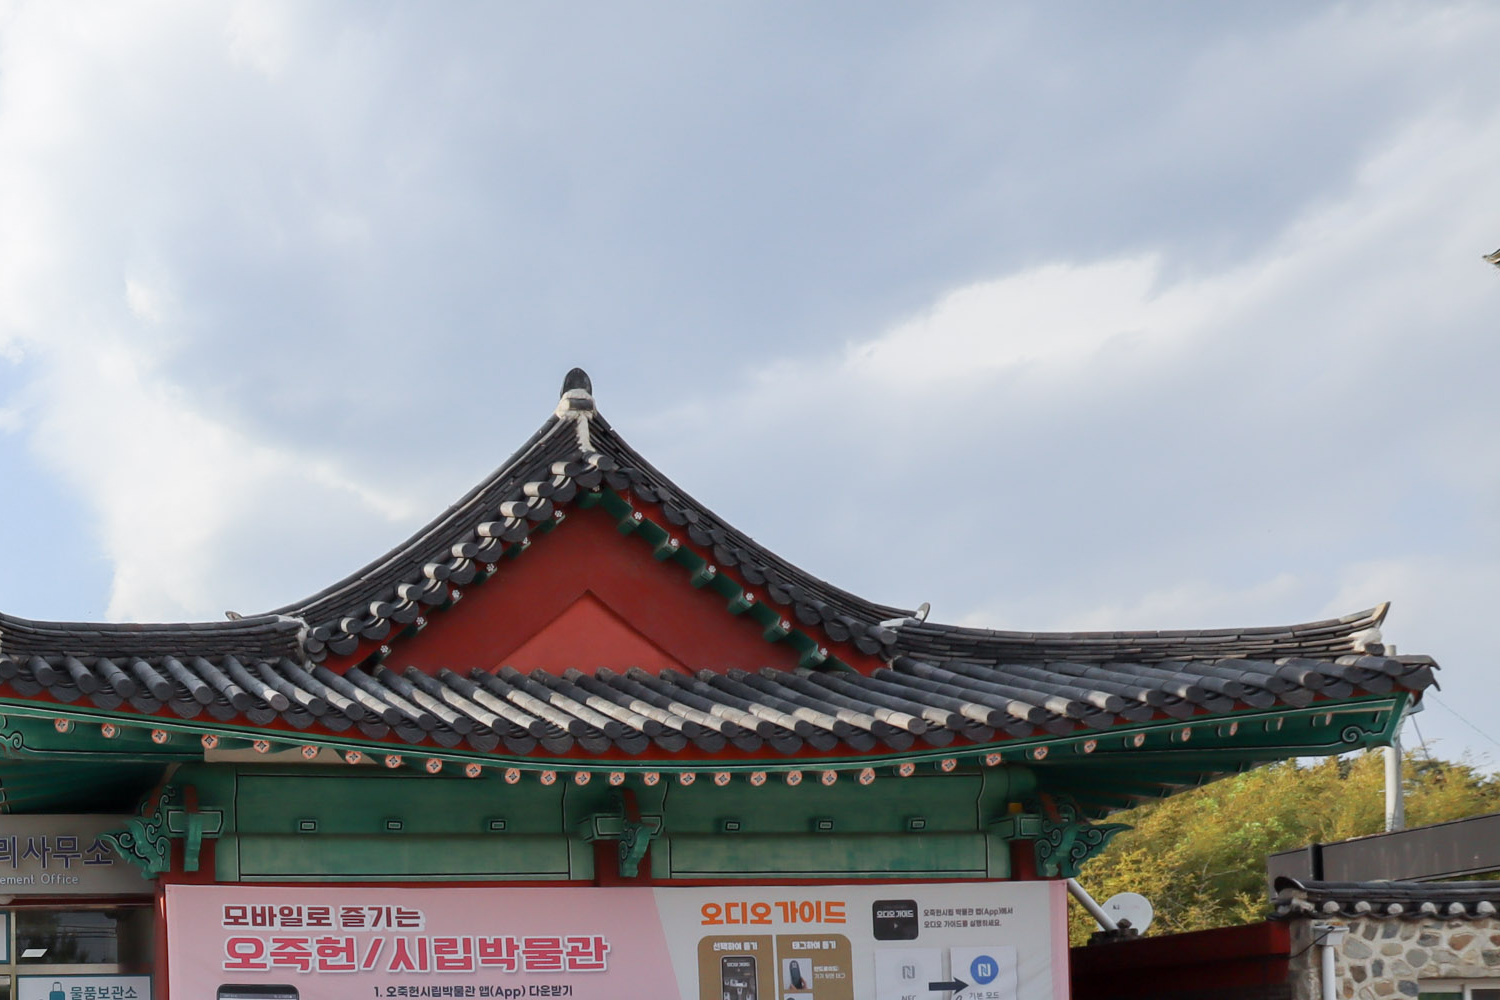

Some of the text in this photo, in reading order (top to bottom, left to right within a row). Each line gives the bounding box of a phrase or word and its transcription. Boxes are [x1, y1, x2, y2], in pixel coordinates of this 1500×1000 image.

[40, 873, 79, 886] Office
[222, 905, 421, 928] 모바일로 즐기는
[223, 935, 610, 971] 오죽헌/시립박물관
[69, 985, 138, 1000] 물품보관소
[373, 985, 573, 999] 1. 오죽헌시립박물관 앱(App) 다운받기
